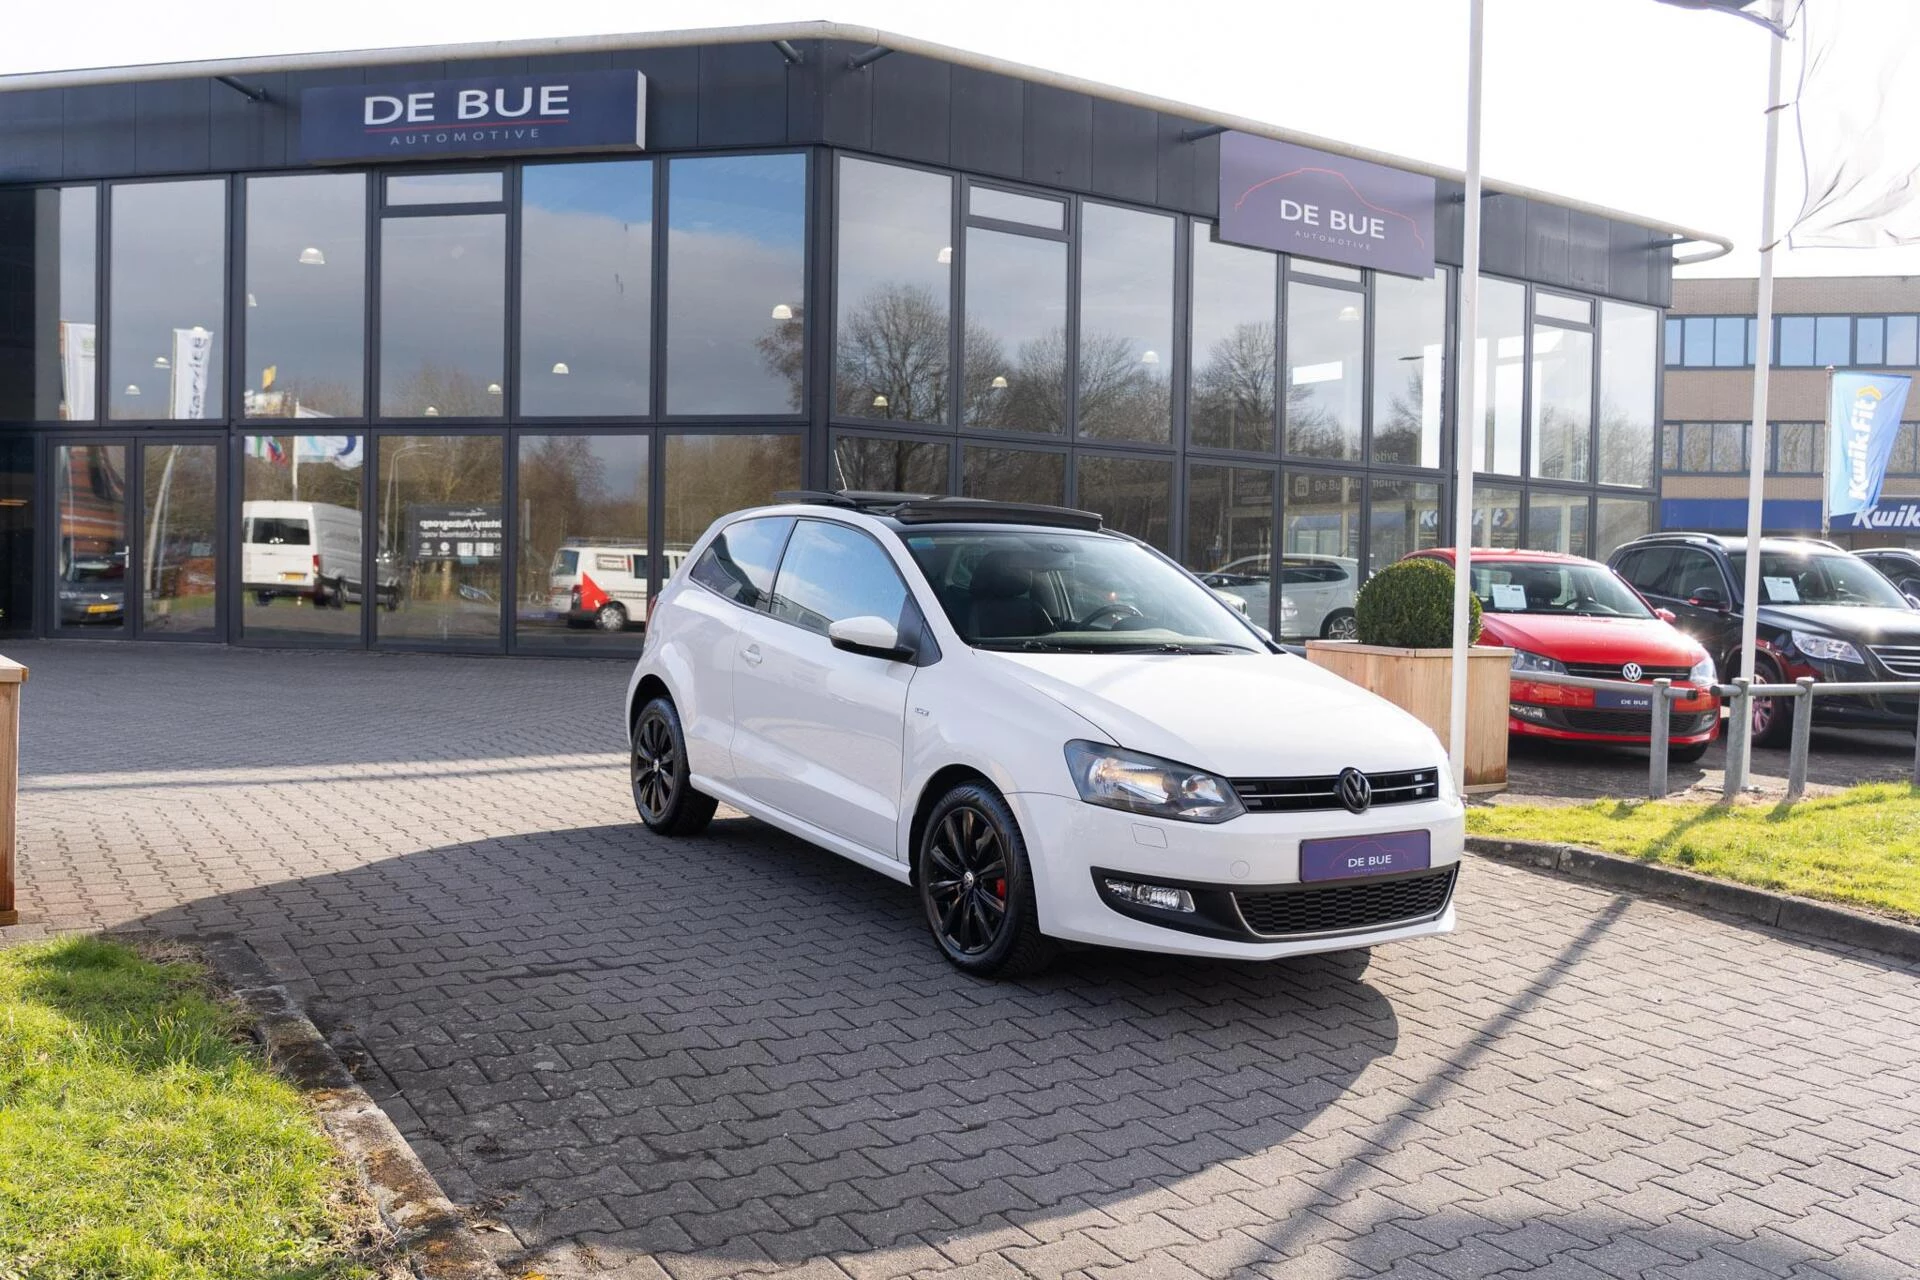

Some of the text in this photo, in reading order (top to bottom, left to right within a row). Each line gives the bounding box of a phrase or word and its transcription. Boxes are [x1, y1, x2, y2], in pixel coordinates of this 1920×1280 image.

[364, 85, 569, 125] DE BUE
[390, 128, 539, 145] AUTOMOTIVE
[1280, 199, 1385, 239] DE BUE
[1295, 230, 1370, 249] AUTOMOTIVE
[1853, 504, 1920, 529] Kwik
[1348, 855, 1392, 868] DE BUE
